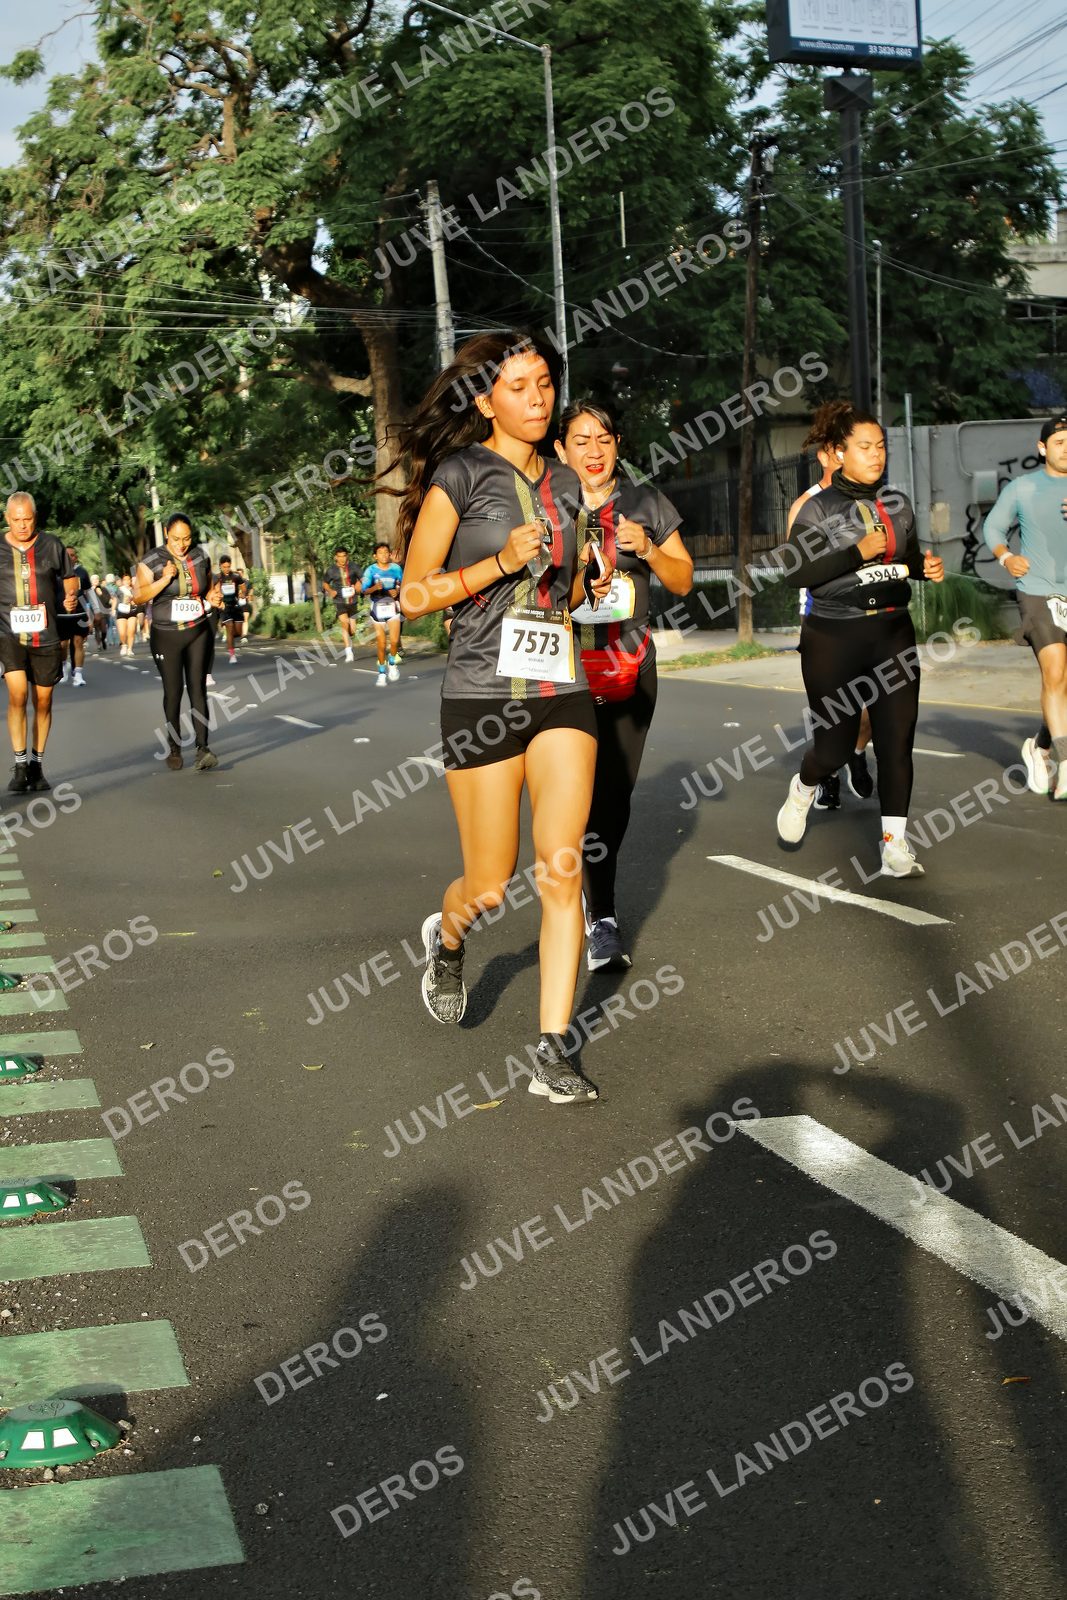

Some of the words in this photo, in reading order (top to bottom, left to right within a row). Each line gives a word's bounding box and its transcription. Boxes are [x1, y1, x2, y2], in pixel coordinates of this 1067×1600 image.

[868, 44, 877, 53] 33
[866, 566, 899, 583] 3944
[175, 603, 200, 611] 10306
[14, 613, 42, 623] 10307
[512, 628, 560, 656] 7573
